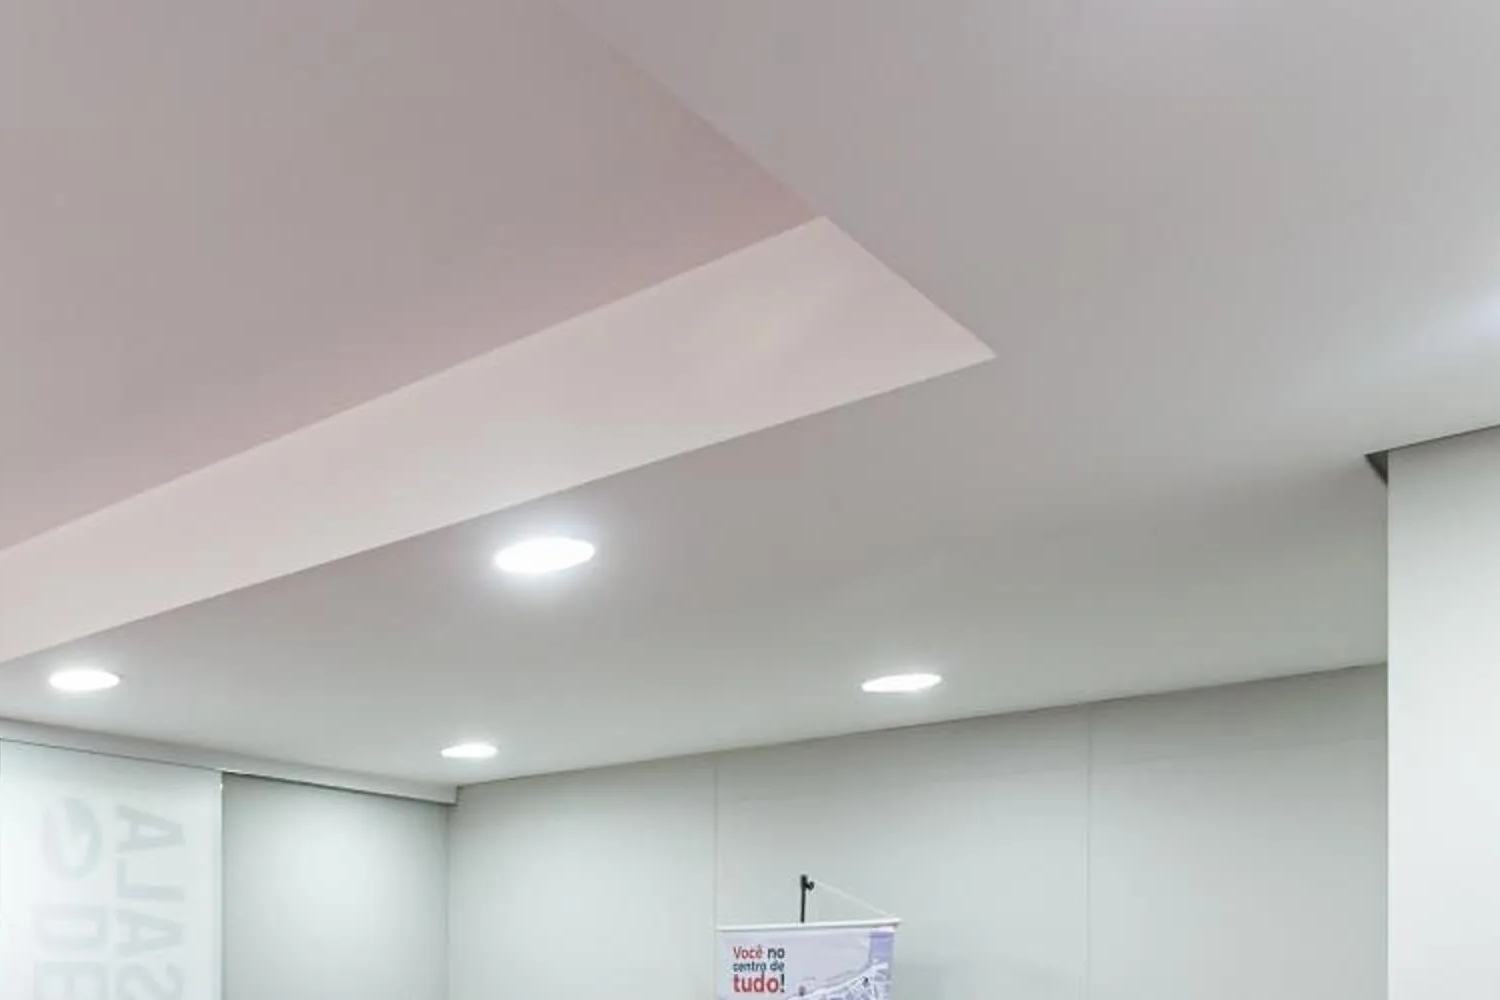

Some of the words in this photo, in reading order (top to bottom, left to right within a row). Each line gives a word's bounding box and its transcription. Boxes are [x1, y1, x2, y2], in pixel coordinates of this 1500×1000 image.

[732, 944, 763, 959] Você
[767, 947, 785, 959] no
[732, 961, 767, 972] centro
[769, 960, 785, 972] de
[733, 972, 785, 993] tudo!
